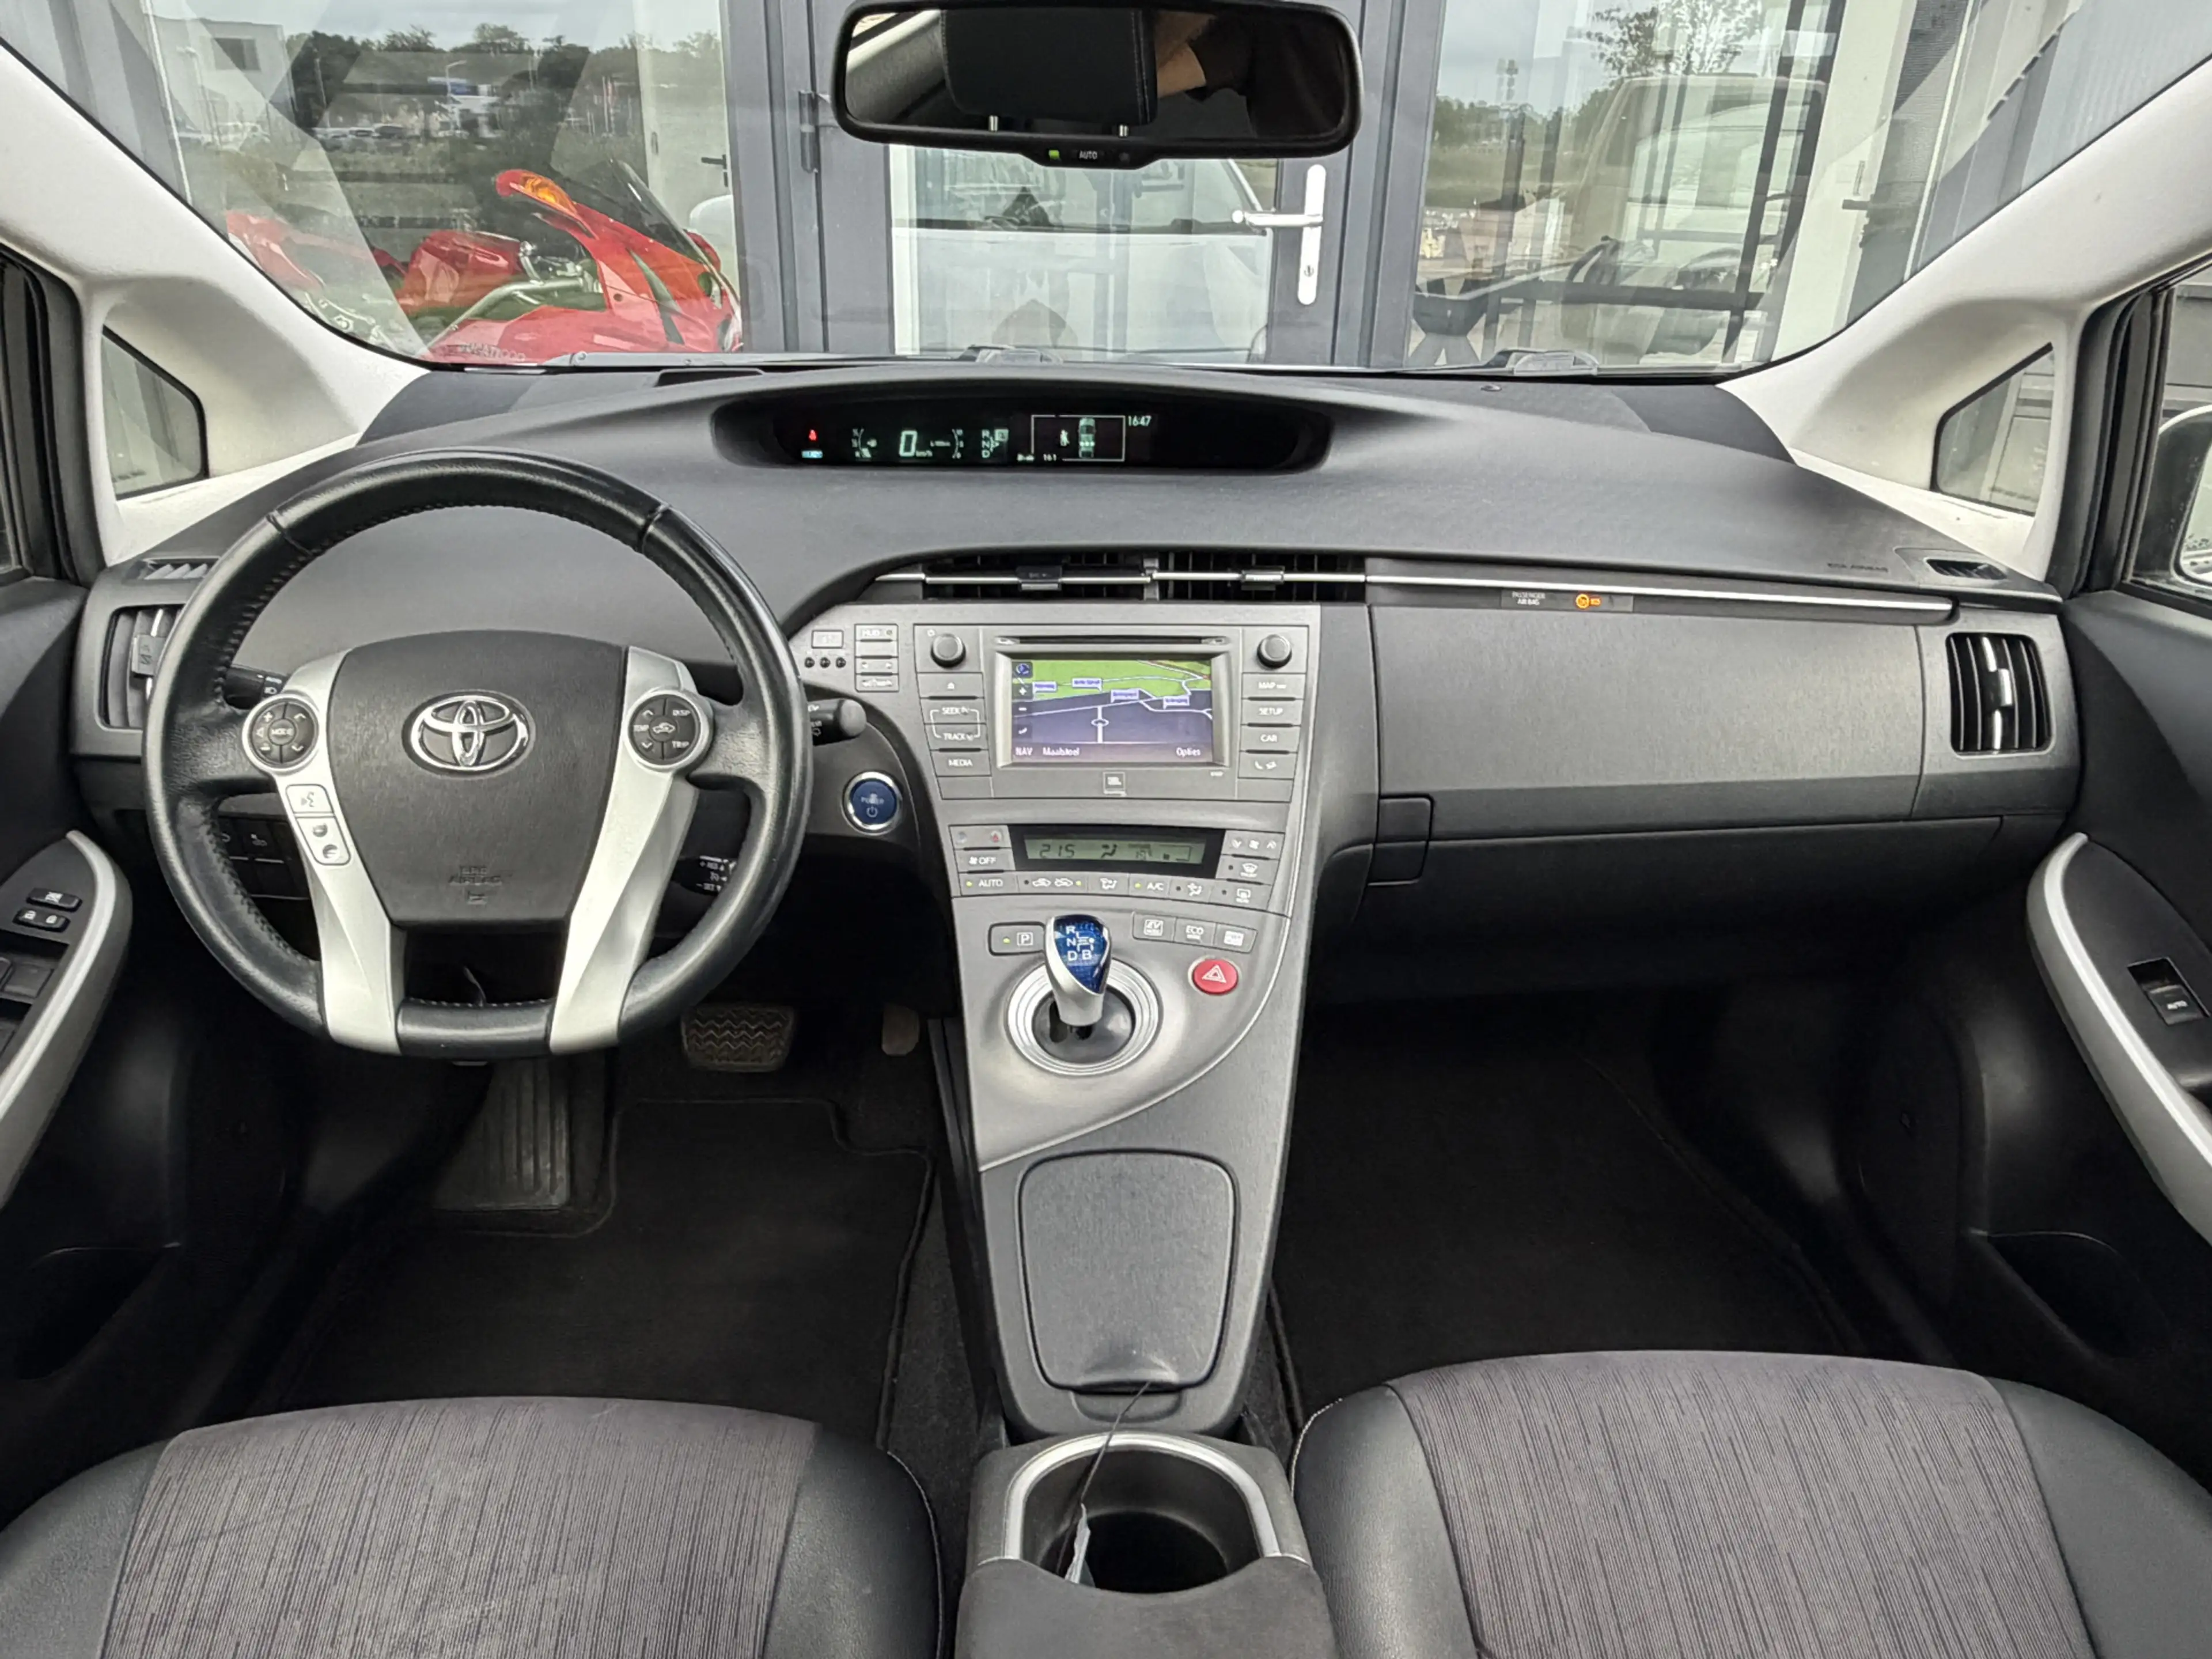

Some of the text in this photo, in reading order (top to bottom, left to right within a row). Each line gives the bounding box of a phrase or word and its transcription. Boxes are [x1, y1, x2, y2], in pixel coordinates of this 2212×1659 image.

[1079, 150, 1097, 160] AUTO
[899, 430, 918, 457] 0
[982, 449, 990, 458] D
[1512, 591, 1546, 599] PASSENGER
[943, 732, 965, 741] TRACK
[672, 740, 690, 748] TRIP
[1015, 747, 1033, 756] NAV
[948, 759, 974, 767] MEDIA
[978, 856, 997, 864] OFF
[979, 878, 1003, 887] AUTO
[1147, 882, 1164, 891] A/C
[1066, 926, 1076, 935] R
[1185, 925, 1205, 935] ECO
[1020, 934, 1030, 945] P
[1066, 937, 1077, 947] N
[1067, 949, 1092, 961] D B
